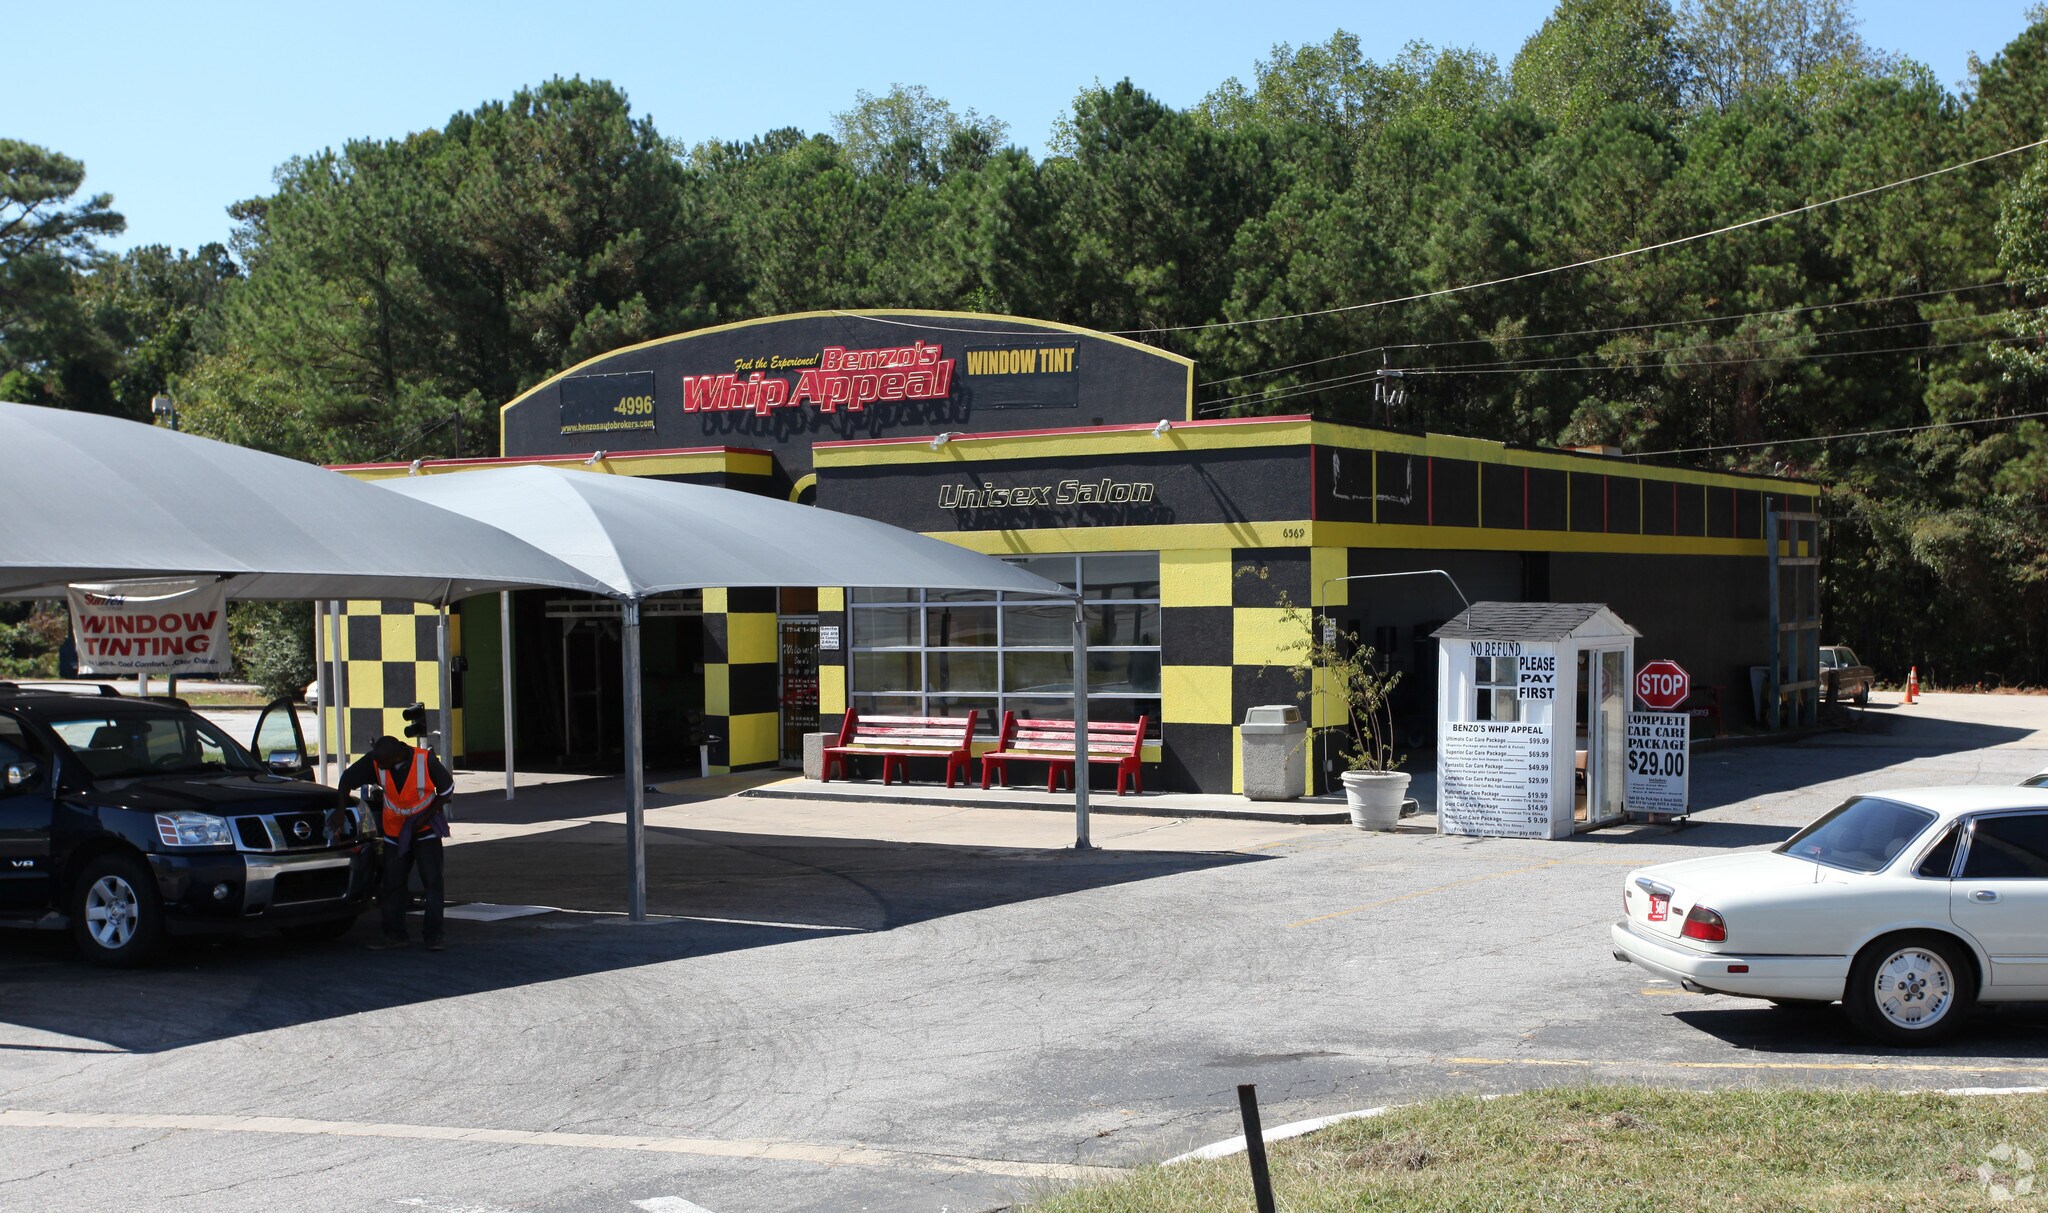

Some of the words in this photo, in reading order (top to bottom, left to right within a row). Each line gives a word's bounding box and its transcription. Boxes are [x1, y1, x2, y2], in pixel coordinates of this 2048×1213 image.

[734, 357, 752, 373] Feel
[755, 357, 768, 370] the
[770, 353, 820, 370] Experience!
[820, 342, 938, 372] Benzo's
[967, 349, 1036, 375] WINDOW
[1039, 348, 1075, 372] TINT
[683, 372, 789, 416] Whip
[788, 358, 951, 412] Appeal
[613, 396, 652, 415] -4996
[560, 420, 654, 432] www.benzosautobrokers.com
[938, 482, 1052, 508] Unisex
[1056, 479, 1155, 504] Salon
[1283, 528, 1305, 538] 6569
[80, 610, 218, 634] WINDOW
[84, 634, 210, 656] TINTING
[1470, 642, 1482, 656] NO
[1485, 642, 1521, 657] REFUND
[1520, 657, 1554, 671] PLEASE
[1521, 674, 1554, 683] PAY
[1641, 674, 1683, 696] STOP
[1520, 688, 1554, 699] FIRST
[1453, 724, 1486, 732] BENZO'S
[1511, 726, 1543, 734] APPEAL
[1628, 726, 1650, 736] CAR
[1628, 738, 1685, 750] PACKAGE
[1628, 749, 1684, 777] $29.00
